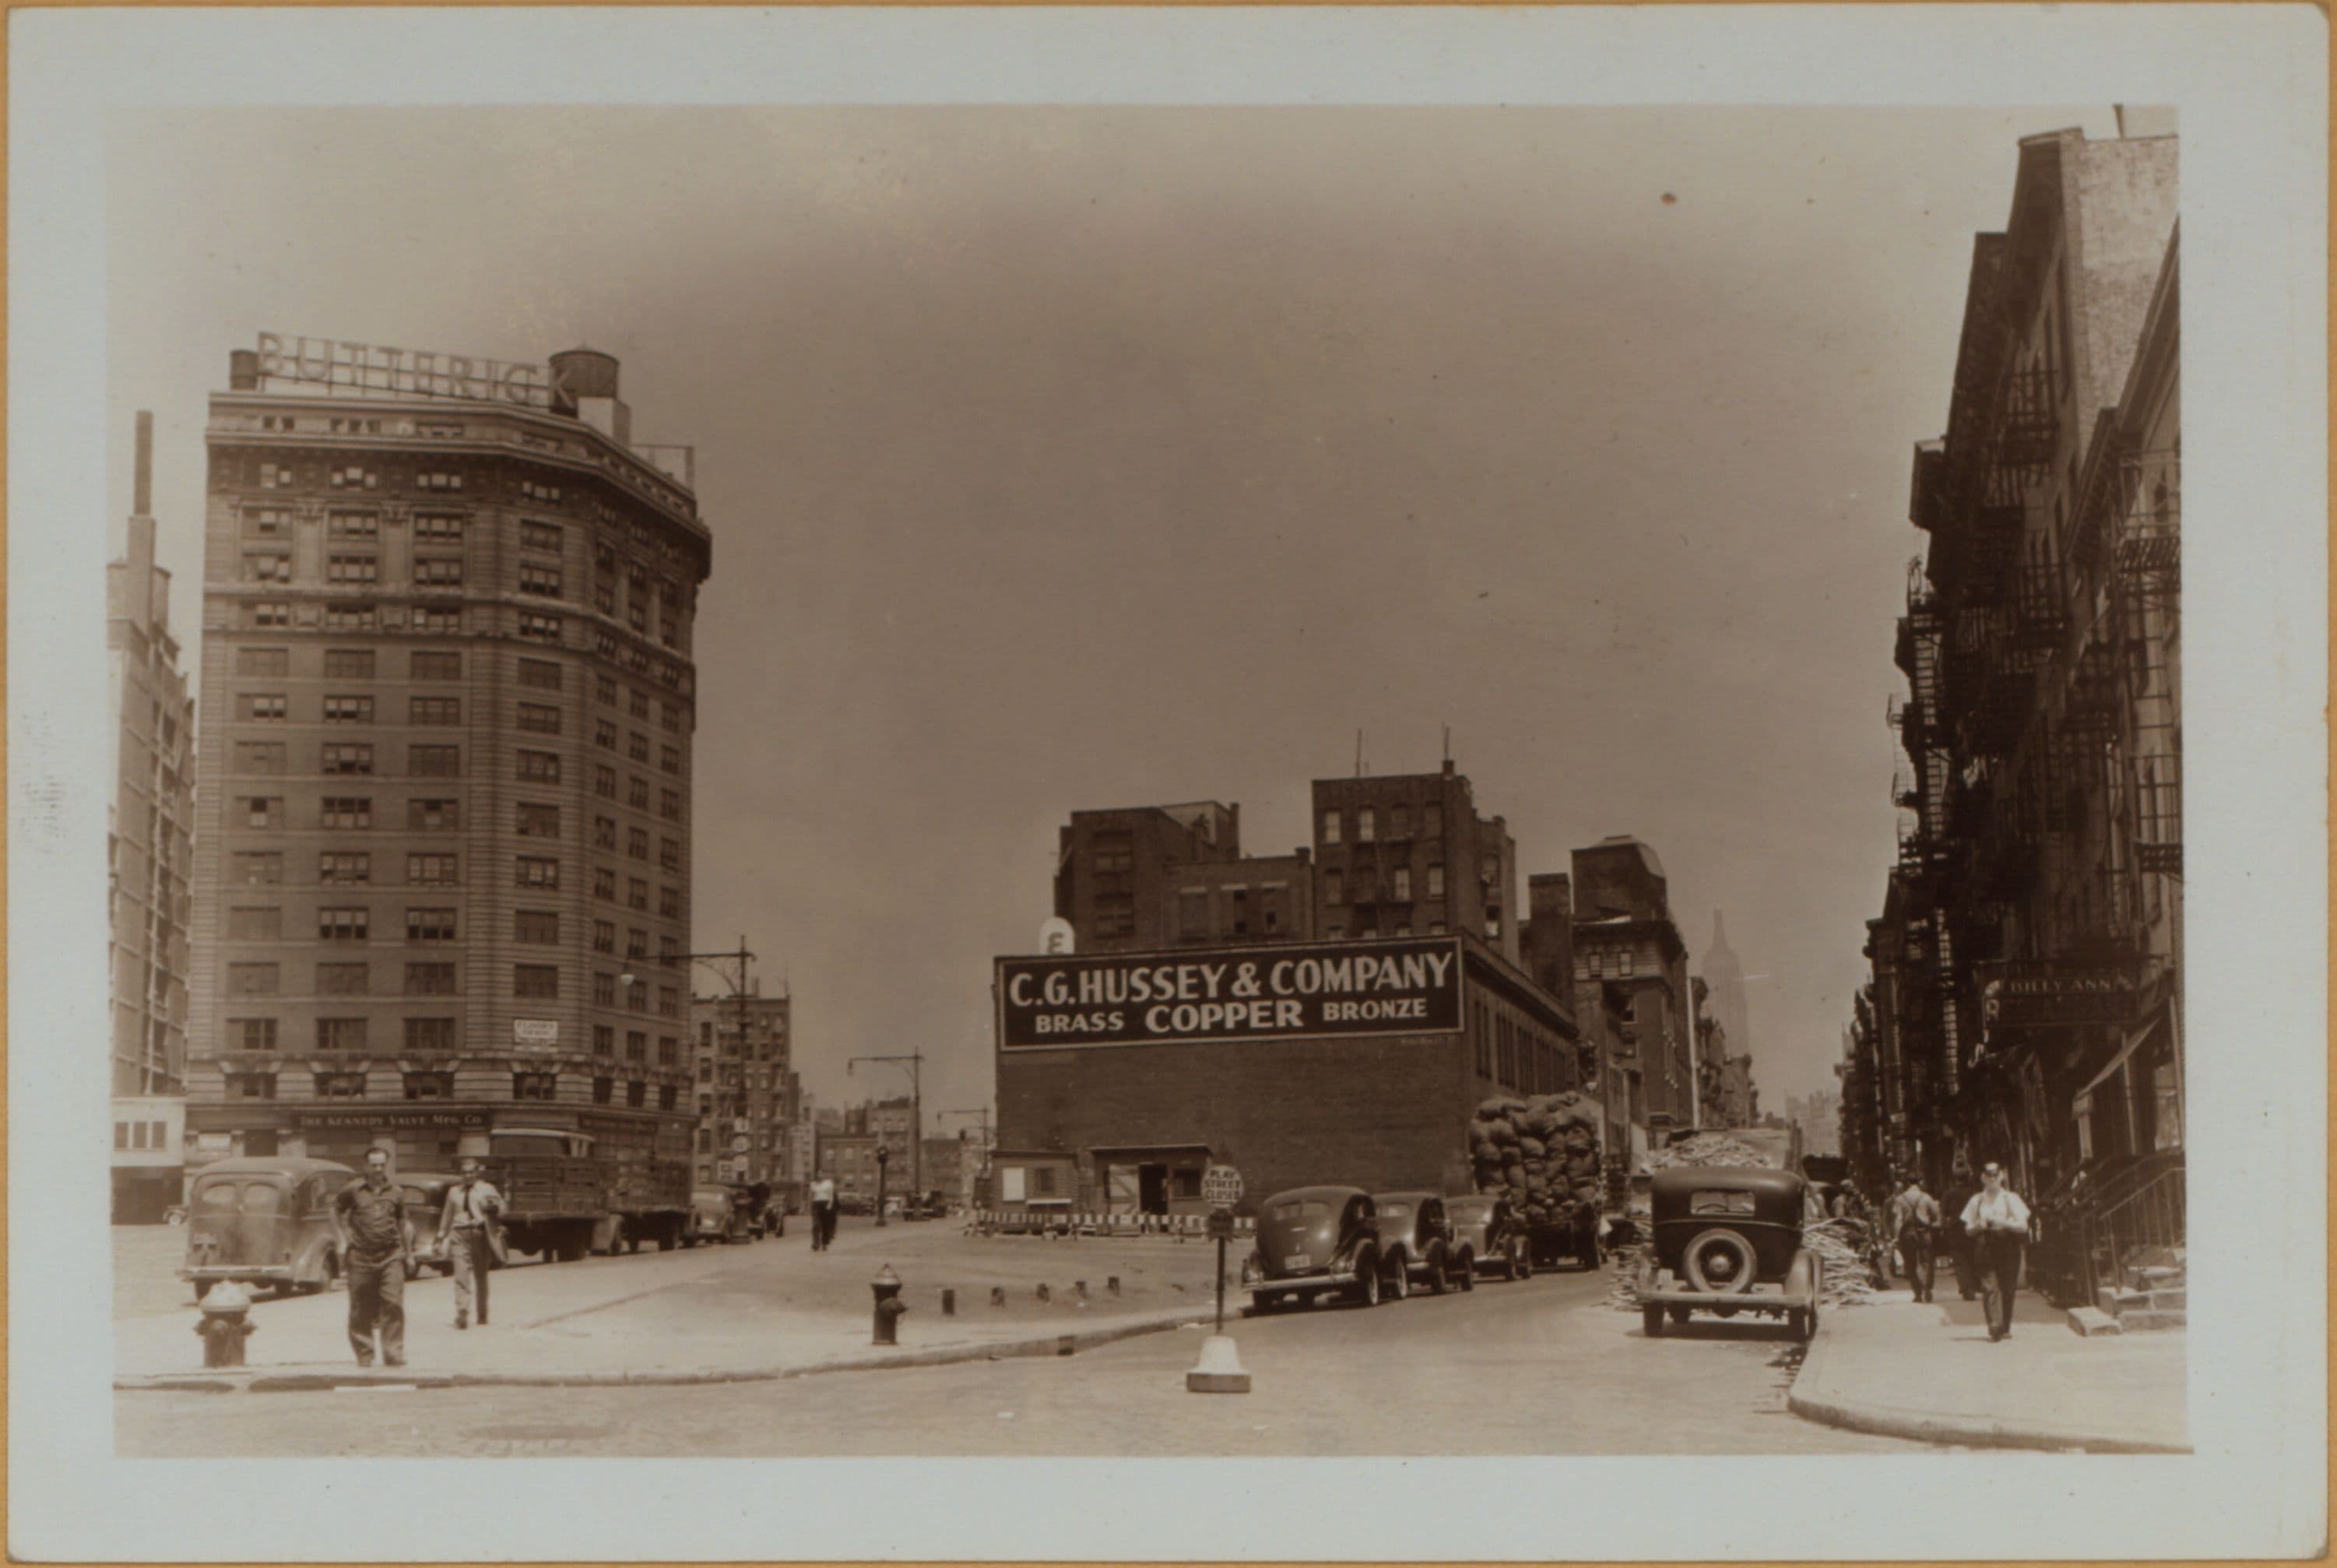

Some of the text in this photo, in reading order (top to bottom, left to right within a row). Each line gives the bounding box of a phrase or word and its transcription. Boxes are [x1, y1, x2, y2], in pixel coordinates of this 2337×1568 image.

[258, 332, 576, 406] BUTTERICK
[1231, 962, 1261, 997] &
[1270, 951, 1453, 994] COMPANY
[1035, 998, 1427, 1033] BRASS COPPER BRONZE
[1204, 1180, 1241, 1189] STREET
